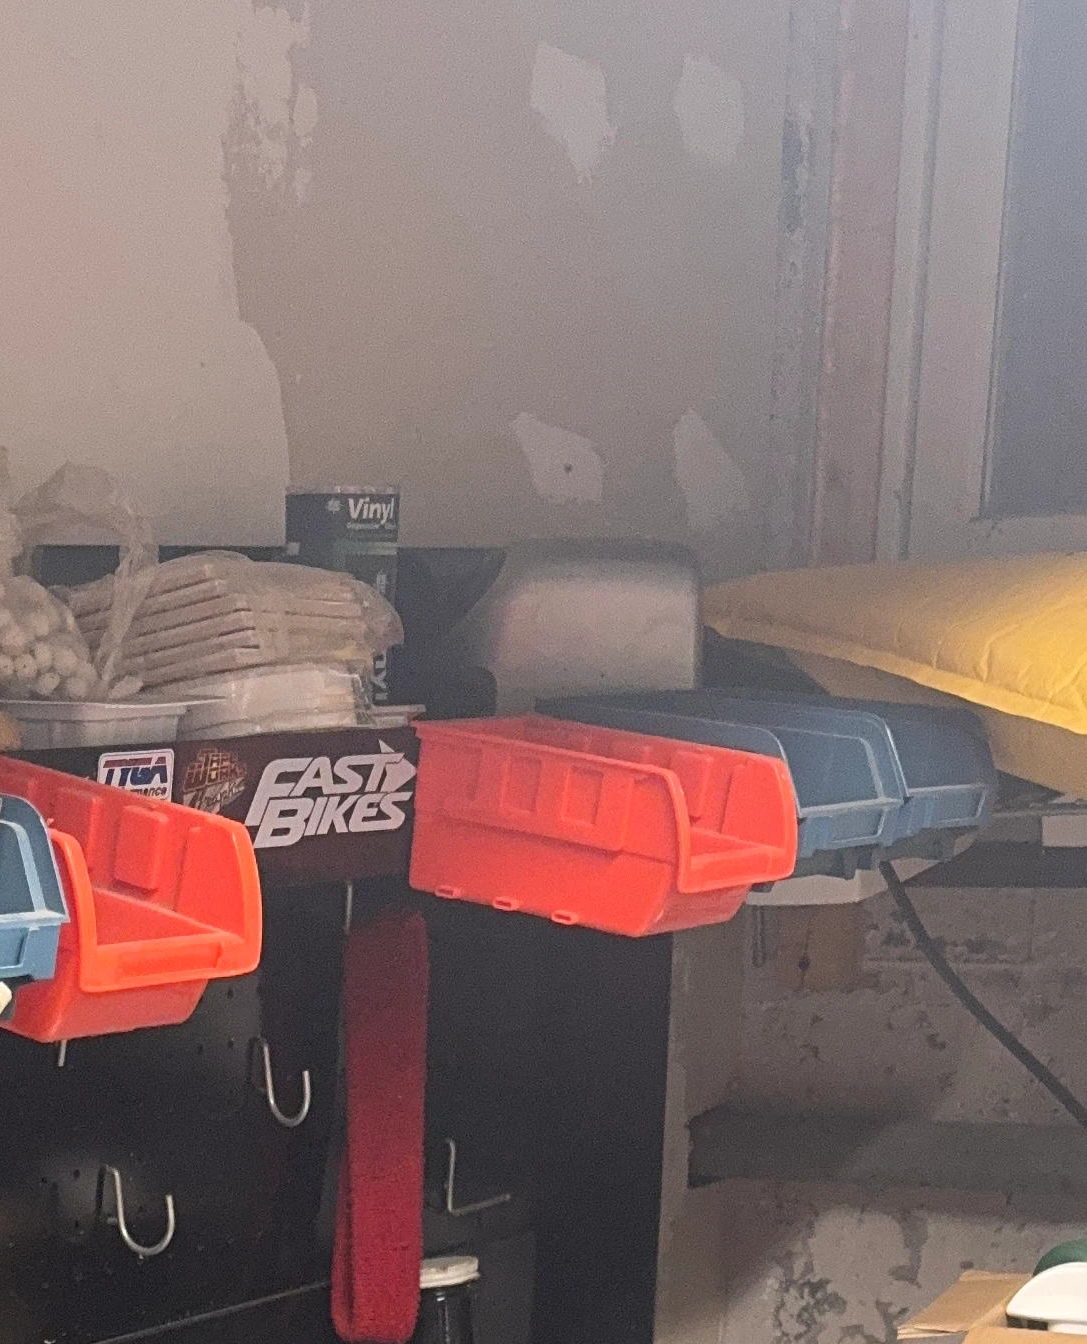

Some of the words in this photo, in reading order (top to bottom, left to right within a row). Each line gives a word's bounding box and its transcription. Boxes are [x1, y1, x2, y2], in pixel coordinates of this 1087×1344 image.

[348, 497, 394, 525] Vinyl
[245, 753, 405, 826] FAST
[253, 791, 413, 848] BIKES
